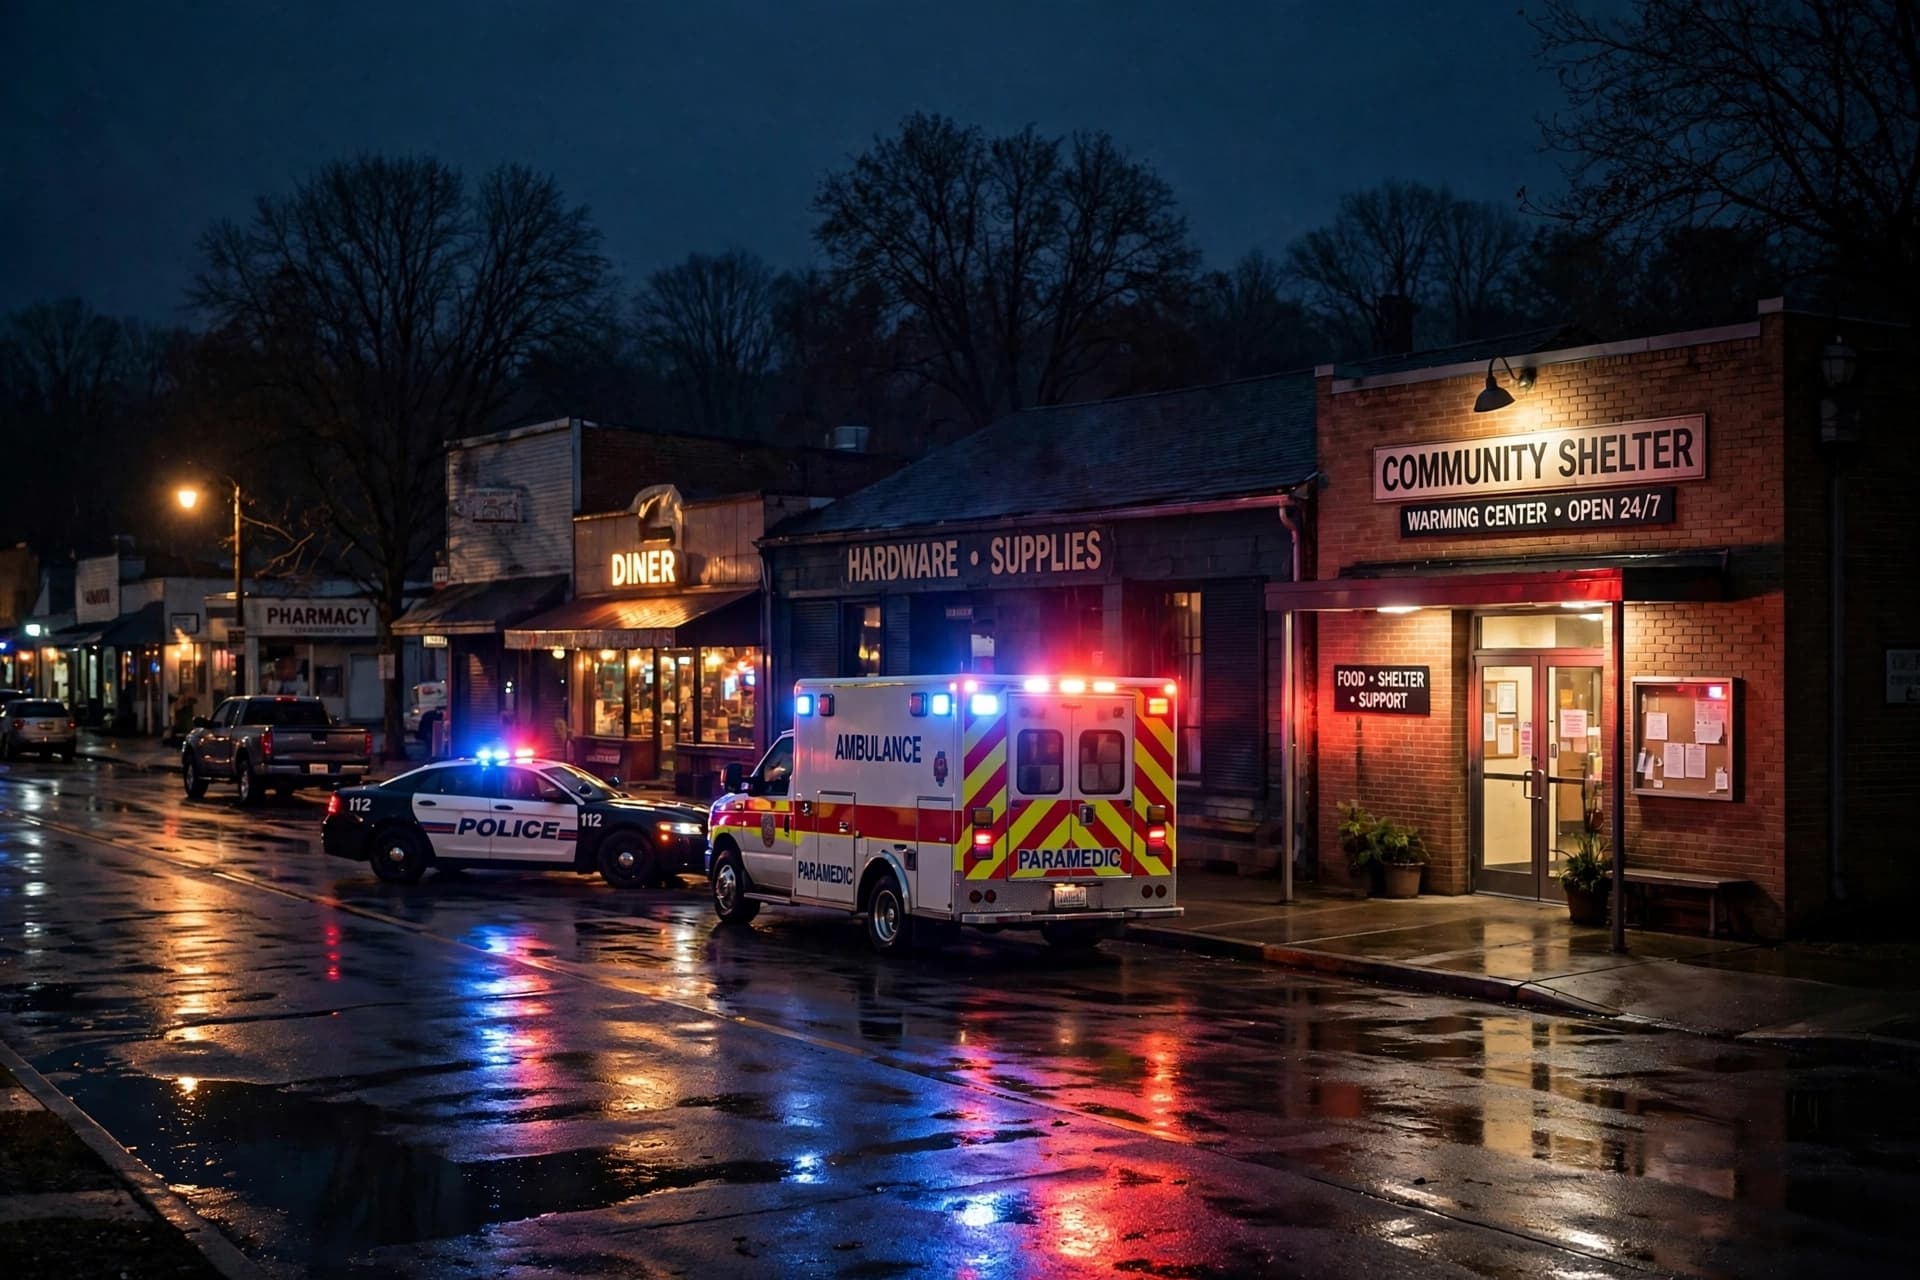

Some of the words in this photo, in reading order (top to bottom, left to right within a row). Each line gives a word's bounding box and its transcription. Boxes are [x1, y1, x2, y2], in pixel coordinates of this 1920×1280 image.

[1382, 441, 1548, 491] COMMUNITY
[1558, 428, 1694, 478] SHELTER
[1407, 506, 1480, 531] WARMING
[1485, 502, 1547, 527] CENTER
[1568, 498, 1614, 523] OPEN
[1620, 493, 1662, 520] 24/7
[848, 540, 959, 583] HARDWARE
[991, 529, 1102, 576] SUPPLIES
[611, 550, 676, 587] DINER
[266, 607, 371, 625] PHARMACY
[1337, 670, 1366, 688] FOOD
[1377, 671, 1425, 688] SHELTER
[1358, 692, 1408, 710] SUPPORT
[835, 734, 922, 763] AMBULANCE
[349, 797, 371, 812] 112
[458, 817, 560, 840] POLICE
[580, 813, 602, 828] 112
[1018, 848, 1122, 870] PARAMEDIC
[798, 861, 853, 885] PARAMEDIC
